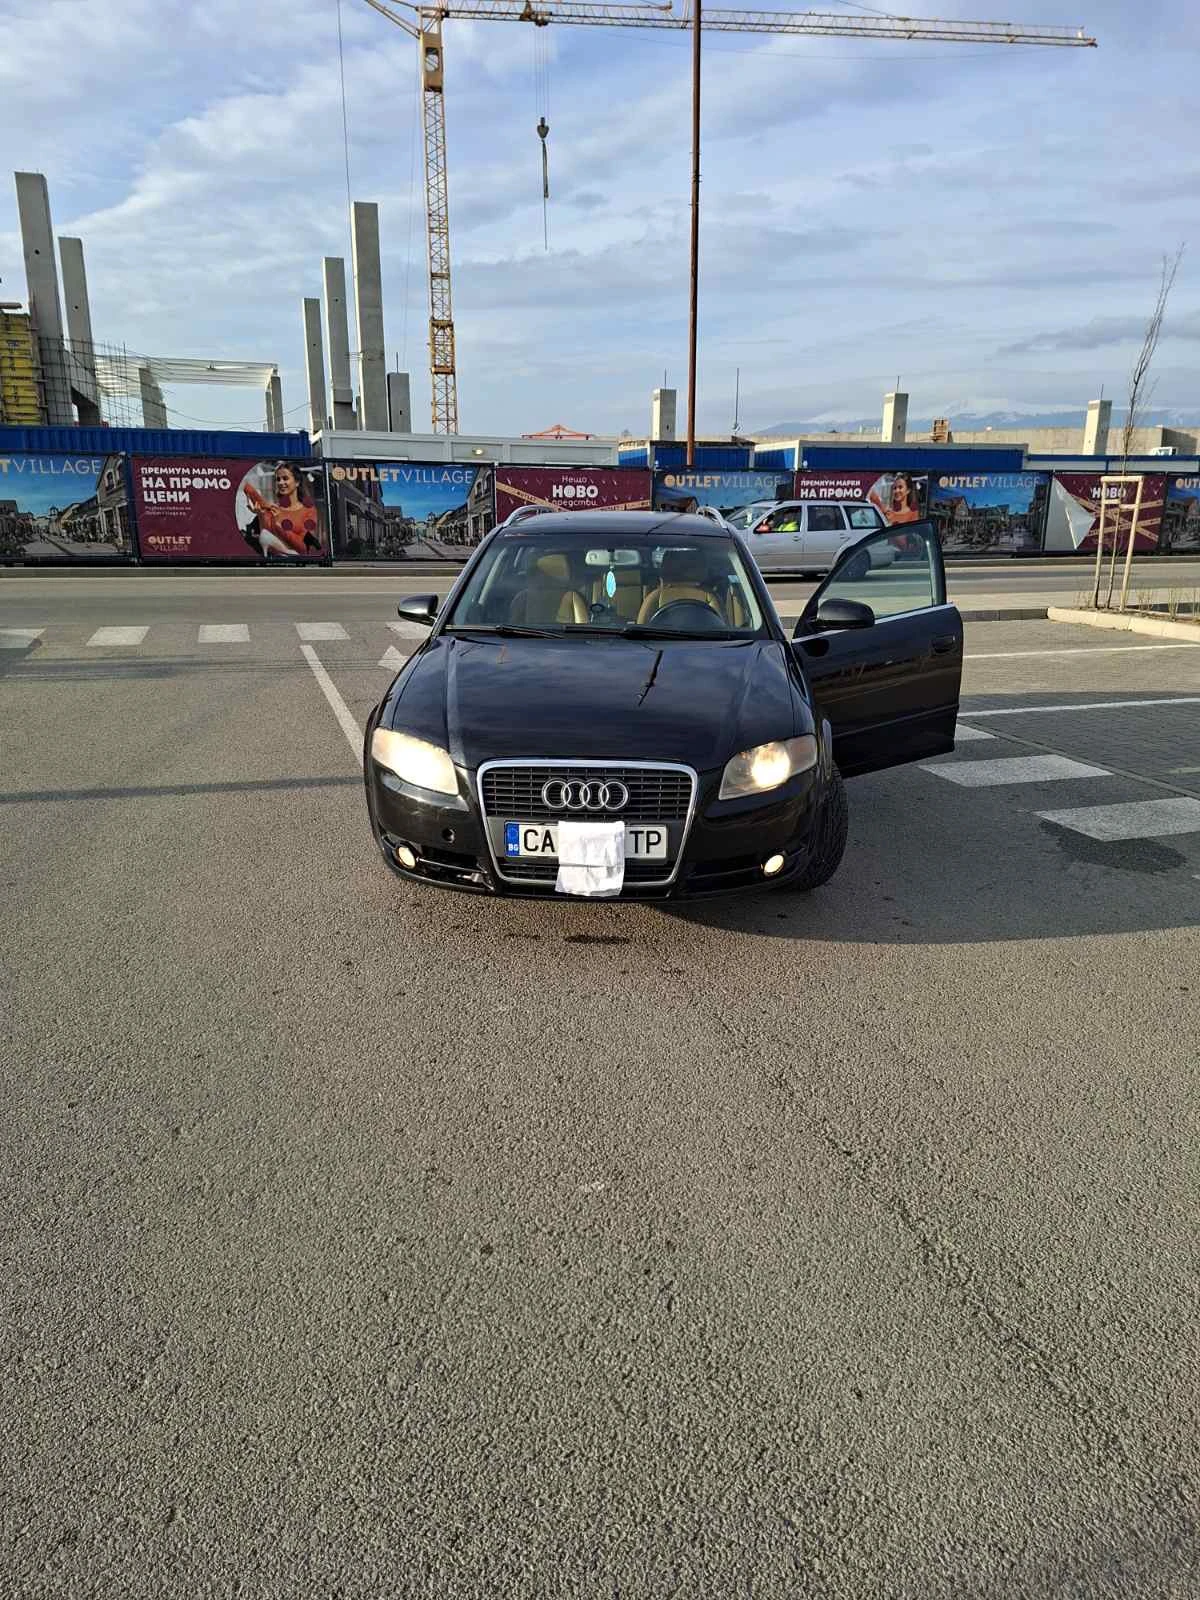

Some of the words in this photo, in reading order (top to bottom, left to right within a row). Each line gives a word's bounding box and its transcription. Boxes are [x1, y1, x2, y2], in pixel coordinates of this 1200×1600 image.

[141, 466, 190, 475] ПРЕМИУМ
[192, 468, 227, 476] МАРКИ
[142, 477, 166, 488] НА
[169, 477, 231, 489] ПРОМО
[1175, 478, 1200, 489] OUT
[552, 485, 599, 498] НОВО
[801, 488, 817, 498] НА
[819, 487, 862, 498] ПРОМО
[143, 491, 190, 504] ЦЕНИ
[148, 536, 192, 544] OUTLET
[508, 843, 519, 851] BG
[523, 829, 556, 853] CA
[629, 830, 662, 854] TP
